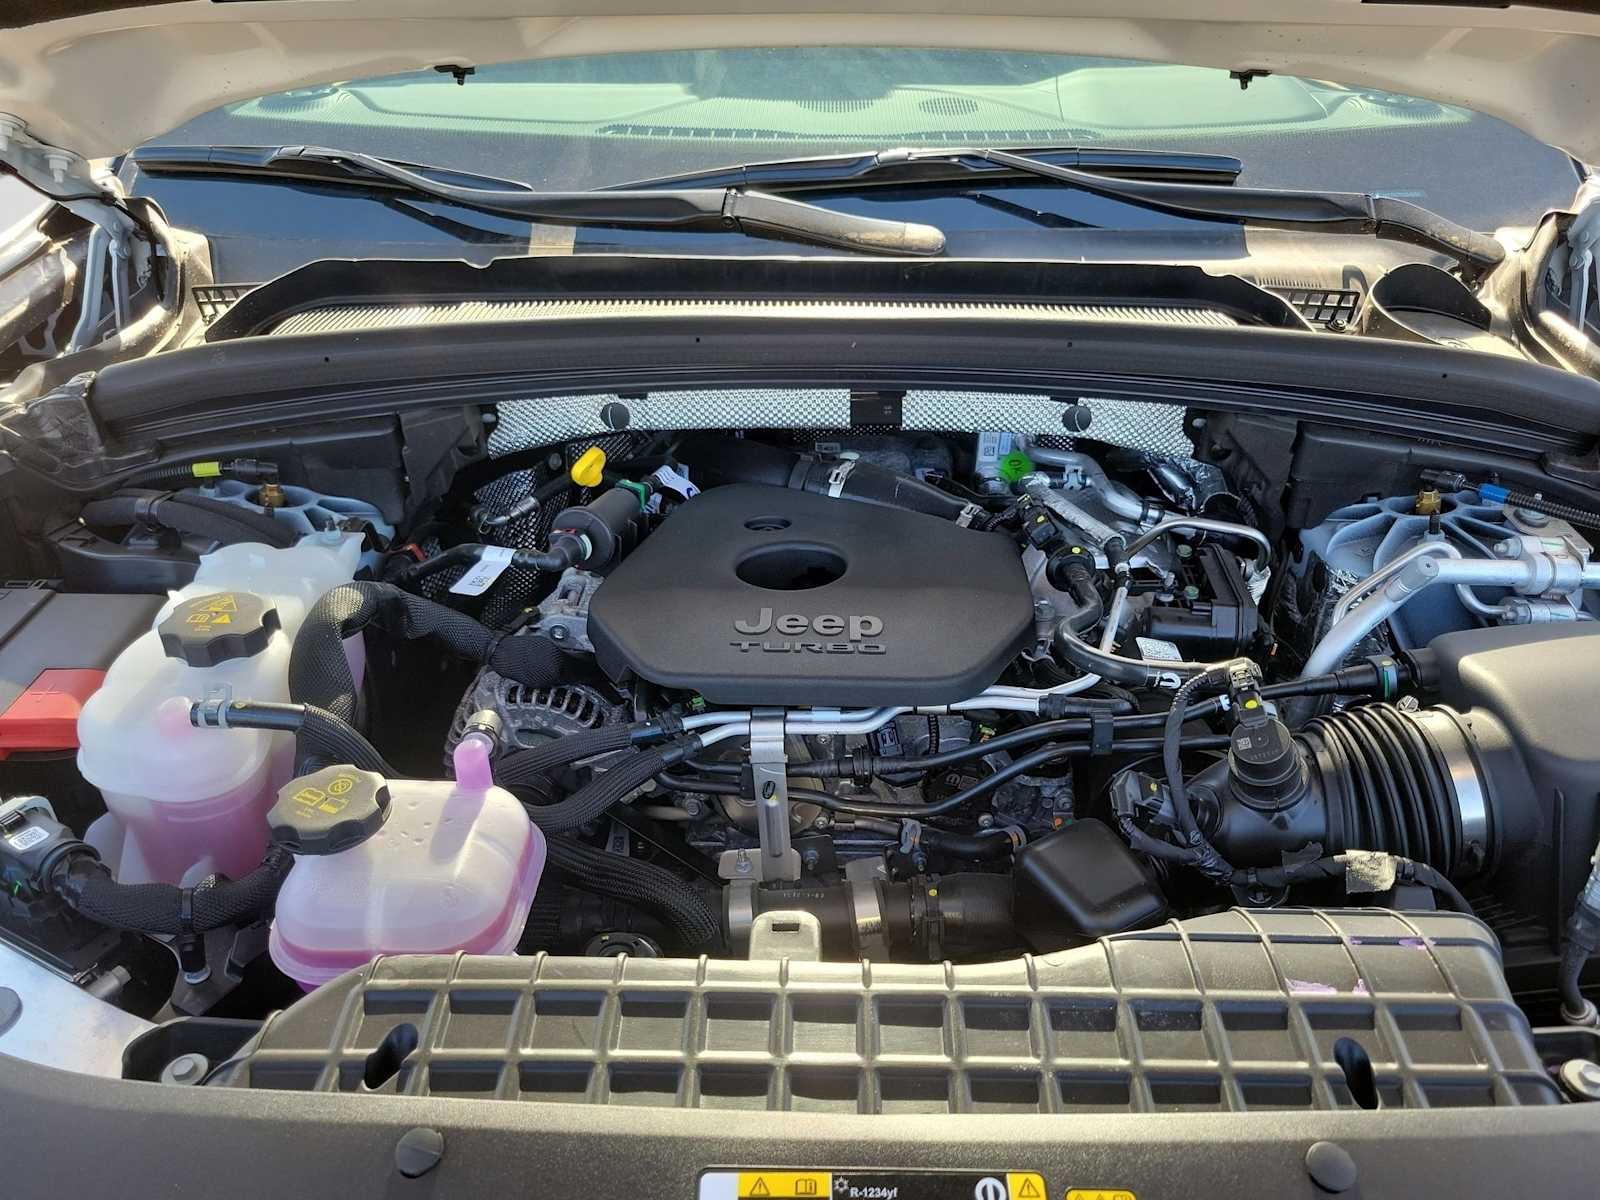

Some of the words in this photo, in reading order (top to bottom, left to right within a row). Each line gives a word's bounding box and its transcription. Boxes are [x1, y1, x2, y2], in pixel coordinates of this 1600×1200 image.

[735, 607, 884, 642] Jeep
[729, 642, 887, 655] TURBO
[849, 1186, 899, 1200] R-1234yf
